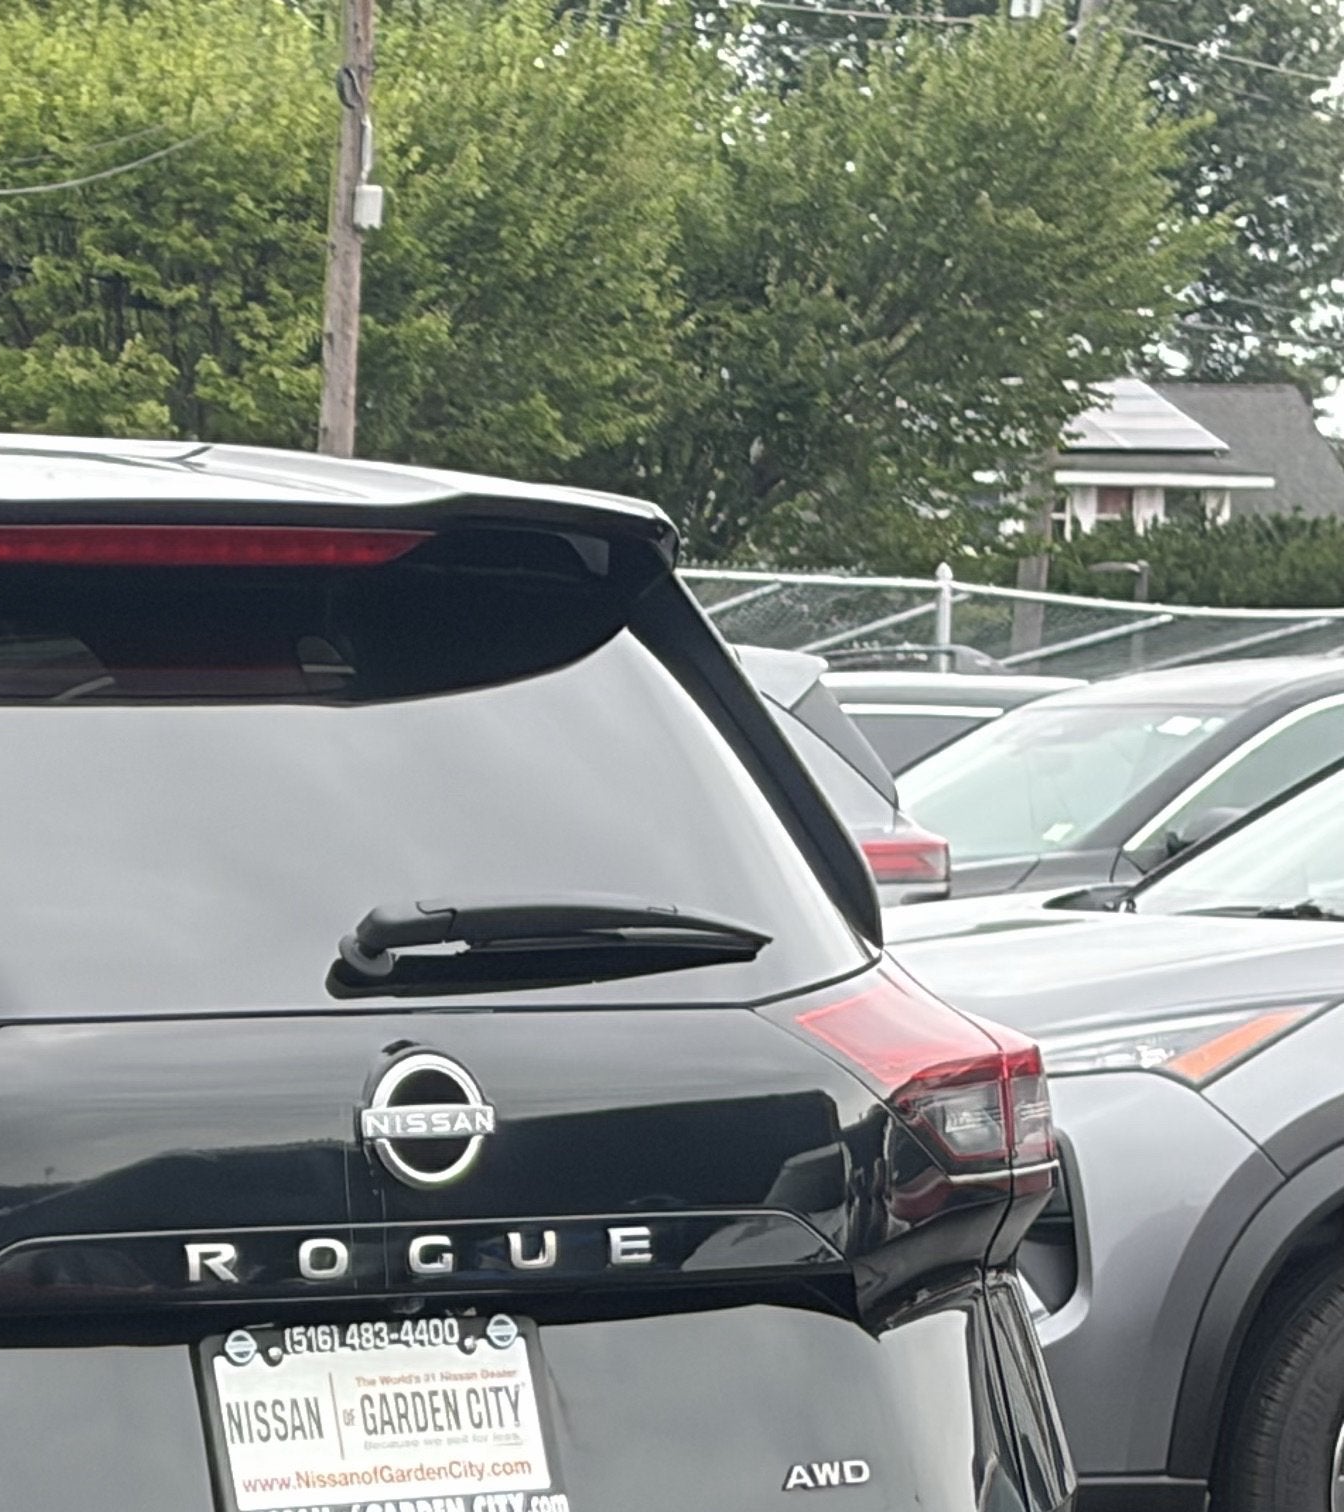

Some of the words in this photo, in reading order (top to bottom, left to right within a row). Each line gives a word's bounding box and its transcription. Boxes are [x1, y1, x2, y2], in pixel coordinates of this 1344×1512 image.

[365, 1107, 495, 1135] NISSAN
[184, 1226, 654, 1283] ROGUE
[283, 1325, 340, 1354] (516)
[345, 1317, 460, 1350] 483-4400
[225, 1396, 325, 1445] NISSAN
[360, 1388, 462, 1436] GARDEN
[466, 1384, 522, 1430] CITY
[242, 1460, 532, 1493] www.NissanofGardenCity.com
[784, 1459, 871, 1490] AWD
